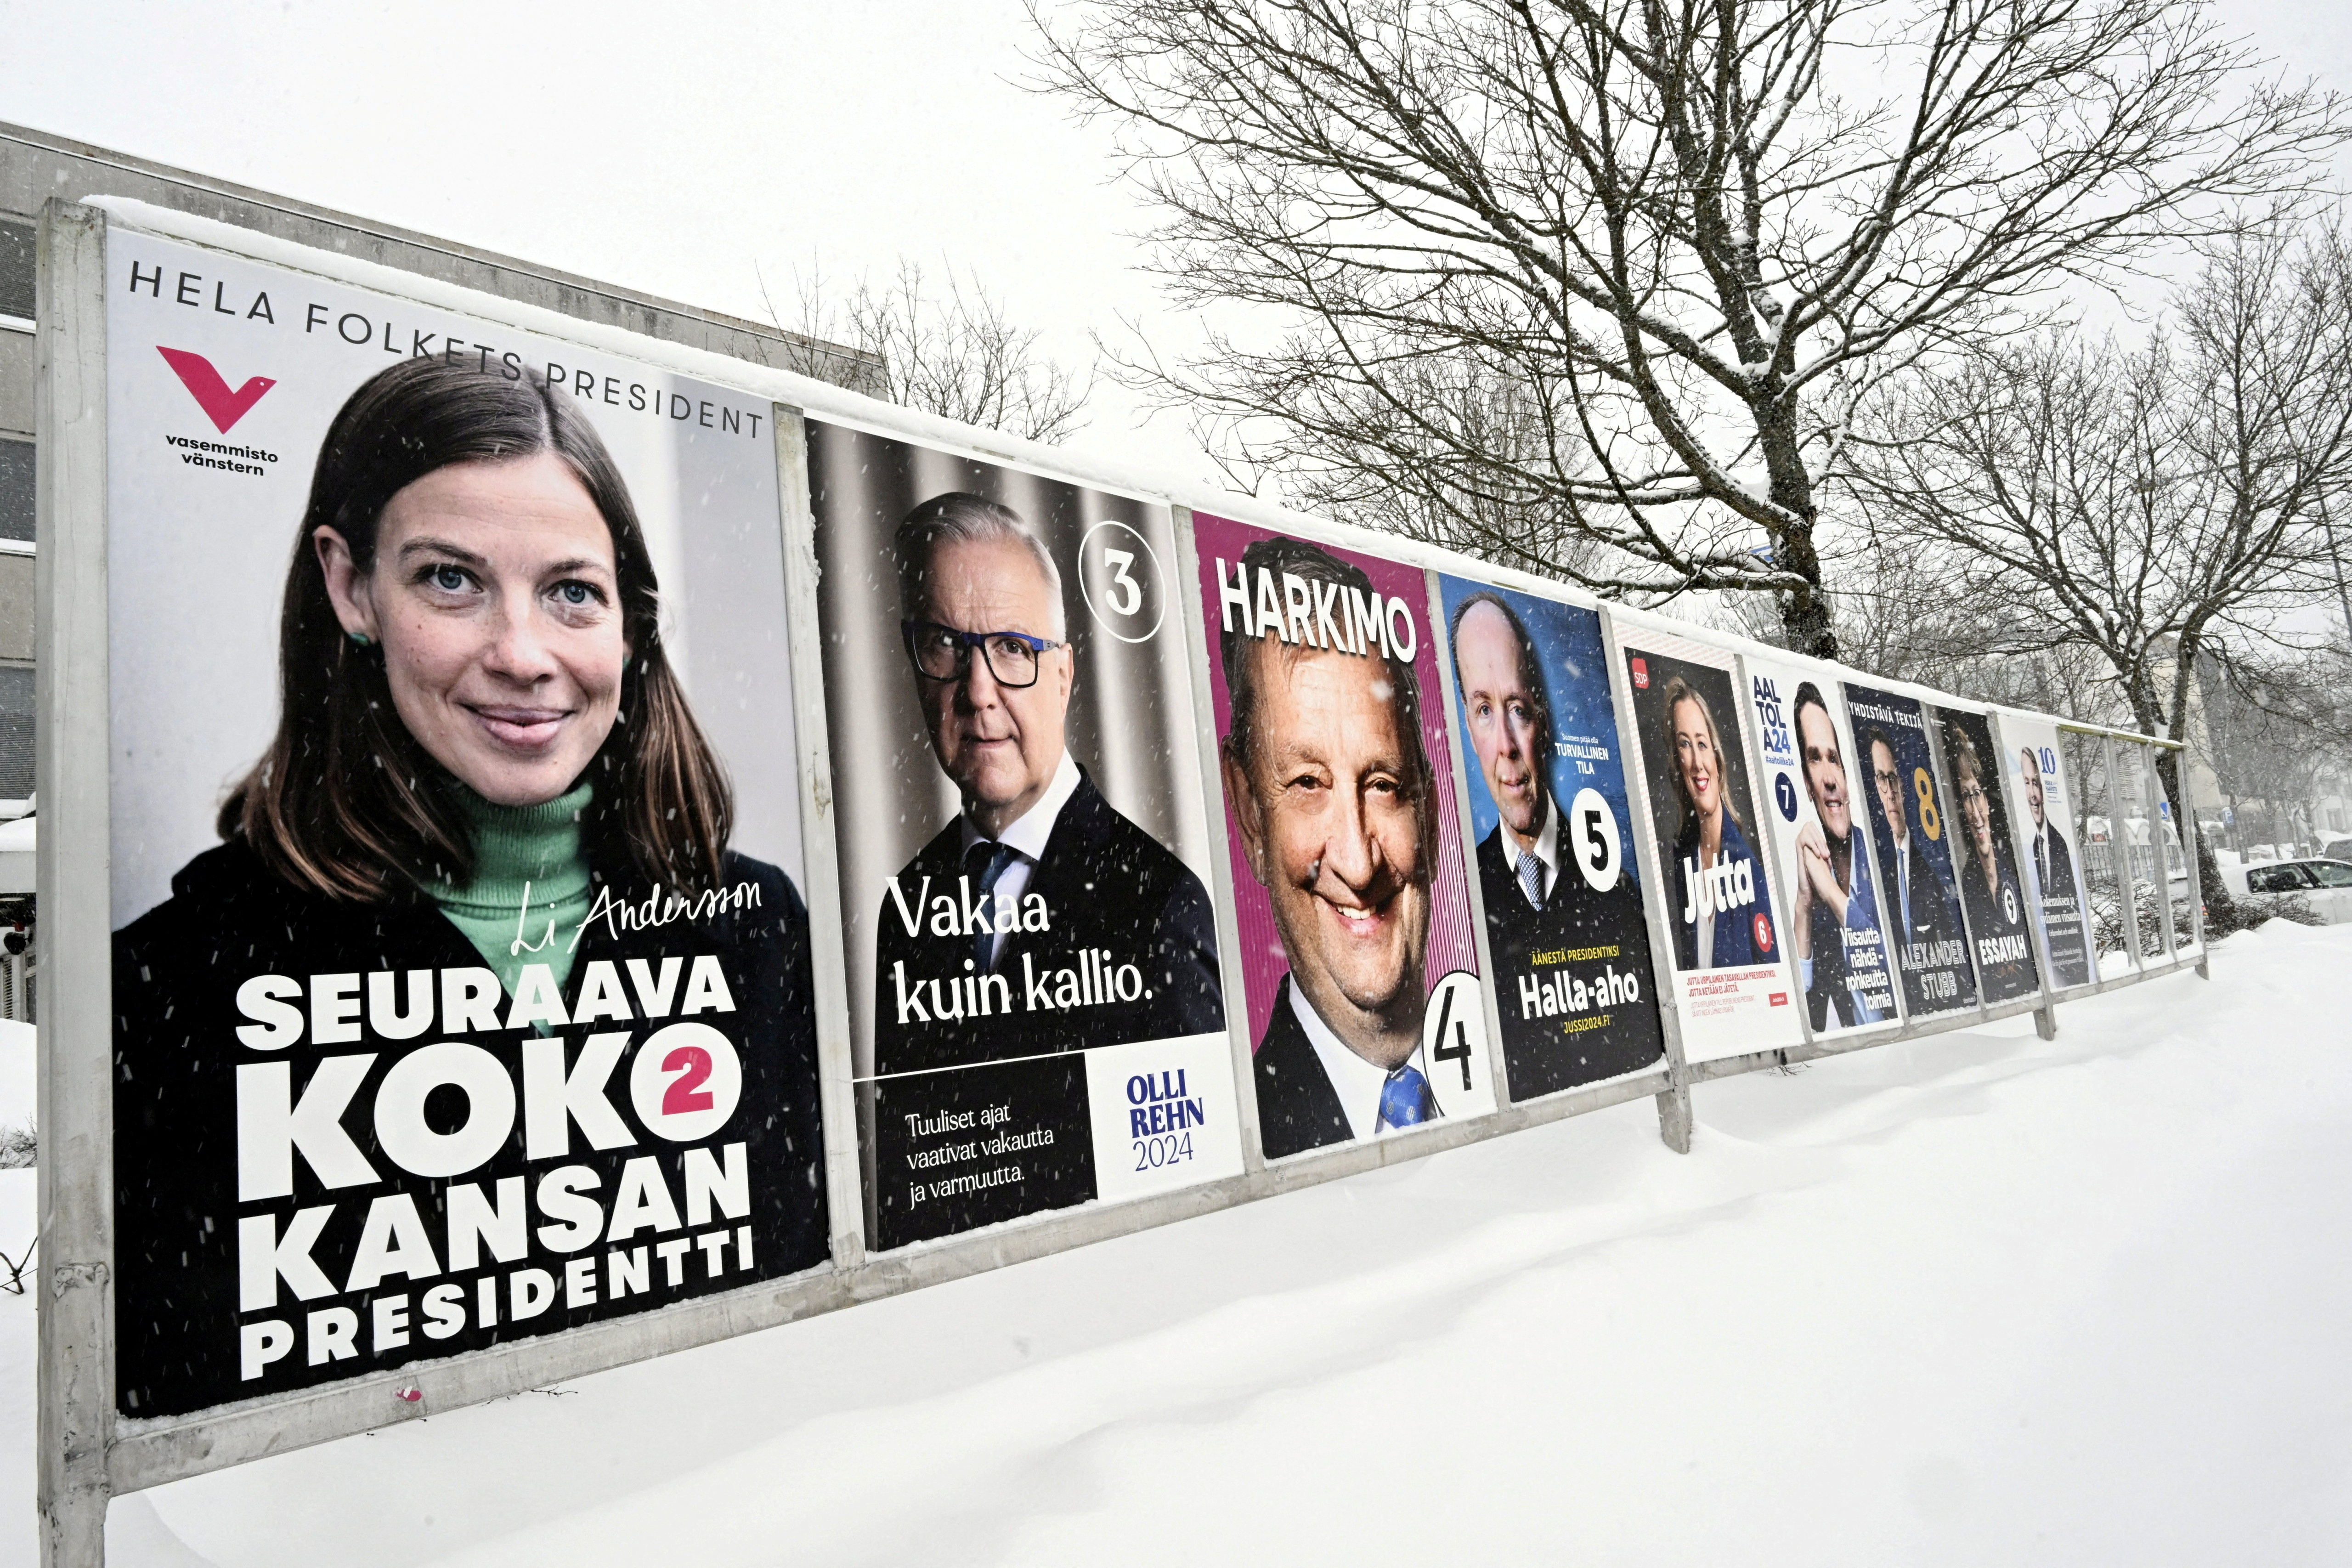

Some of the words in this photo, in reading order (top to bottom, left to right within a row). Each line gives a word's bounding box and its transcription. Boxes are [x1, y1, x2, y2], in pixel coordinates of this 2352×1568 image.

[130, 260, 274, 324] HELA
[306, 303, 521, 381] FOLKETS
[546, 362, 762, 438] PRESIDENT
[166, 435, 278, 463] vasemmisto
[182, 453, 264, 476] vänstern
[1104, 547, 1142, 616] 3
[1216, 557, 1417, 663] HARKIMO
[1634, 672, 1647, 685] SDP
[1754, 675, 1781, 703] AAL
[1755, 700, 1787, 729] TOL
[1848, 701, 1894, 723] YHDISTÄVÄ
[1894, 711, 1923, 729] TEKIJÄ
[1555, 742, 1609, 760] TURVALLINEN
[1562, 733, 1580, 742] Suomen
[1764, 727, 1791, 754] A24
[1576, 761, 1594, 775] TILA
[2038, 747, 2055, 775] 10
[1781, 784, 1790, 810] 7
[1914, 767, 1940, 841] 8
[2224, 811, 2233, 820] P
[1584, 810, 1609, 872] 5
[1684, 849, 1755, 924] Jutta
[511, 881, 555, 956] Li
[567, 882, 762, 954] Andersson
[885, 875, 1050, 938] Vakaa
[2007, 894, 2014, 919] 9
[1758, 921, 1767, 945] 6
[1839, 927, 1880, 947] Viisautta
[1532, 948, 1566, 966] ÄÄNESTÄ
[1567, 945, 1620, 962] PRESIDENTIKSI
[1849, 947, 1878, 968] nähdä
[1901, 940, 1966, 971] ALEXANDER
[1979, 934, 2027, 965] ESSAYAH
[893, 959, 1011, 1024] kuin
[1022, 947, 1153, 1011] kallio.
[1518, 965, 1639, 1019] Halla-aho
[1687, 977, 1701, 986] JUTTA
[1701, 974, 1724, 985] URPILAINEN
[1724, 972, 1749, 982] TASAVALLAN
[1749, 970, 1776, 980] PRESIDENTIKSI.
[1689, 988, 1702, 997] JOTTA
[1702, 984, 1719, 996] KETÄÄN
[1724, 982, 1740, 993] JÄTETÄ.
[1845, 969, 1888, 991] rohkeutta
[1921, 971, 1957, 1000] STUBB
[236, 955, 736, 1051] SEURAAVA
[1864, 989, 1892, 1010] toimia
[1433, 985, 1472, 1091] 4
[1564, 1014, 1610, 1034] JUSSI2024.FI
[1127, 1069, 1187, 1105] OLLI
[905, 1109, 973, 1137] Tuuliset
[980, 1104, 1011, 1131] ajat
[1130, 1097, 1204, 1138] REHN
[906, 1141, 977, 1170] vaativat
[981, 1128, 1054, 1157] vakautta
[1133, 1132, 1193, 1172] 2024
[910, 1182, 926, 1210] ja
[929, 1165, 1025, 1199] varmuutta.
[238, 1142, 751, 1312] KANSAN
[240, 1225, 753, 1381] PRESIDENTTI
